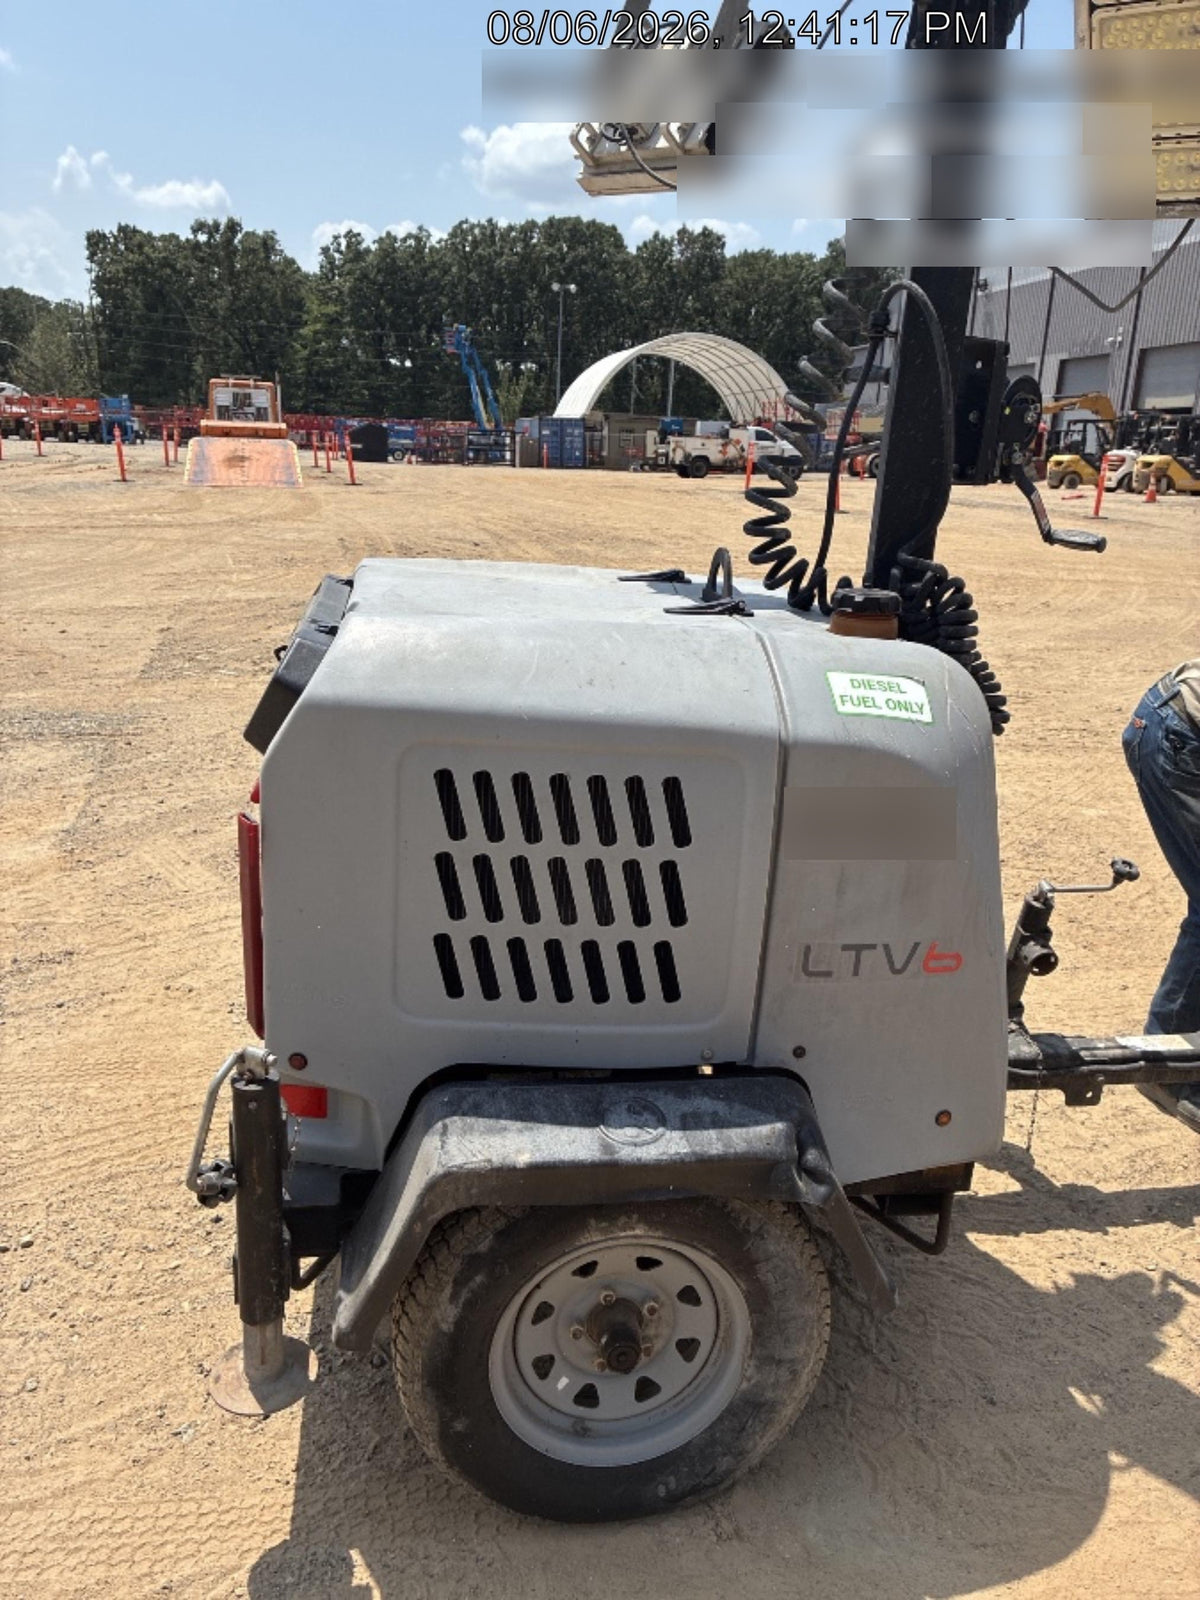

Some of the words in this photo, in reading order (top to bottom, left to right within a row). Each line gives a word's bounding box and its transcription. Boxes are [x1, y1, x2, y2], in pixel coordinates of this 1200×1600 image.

[849, 678, 908, 694] DIESEL
[839, 694, 882, 710] FUEL
[885, 698, 925, 716] ONLY
[801, 941, 964, 978] LTV6
